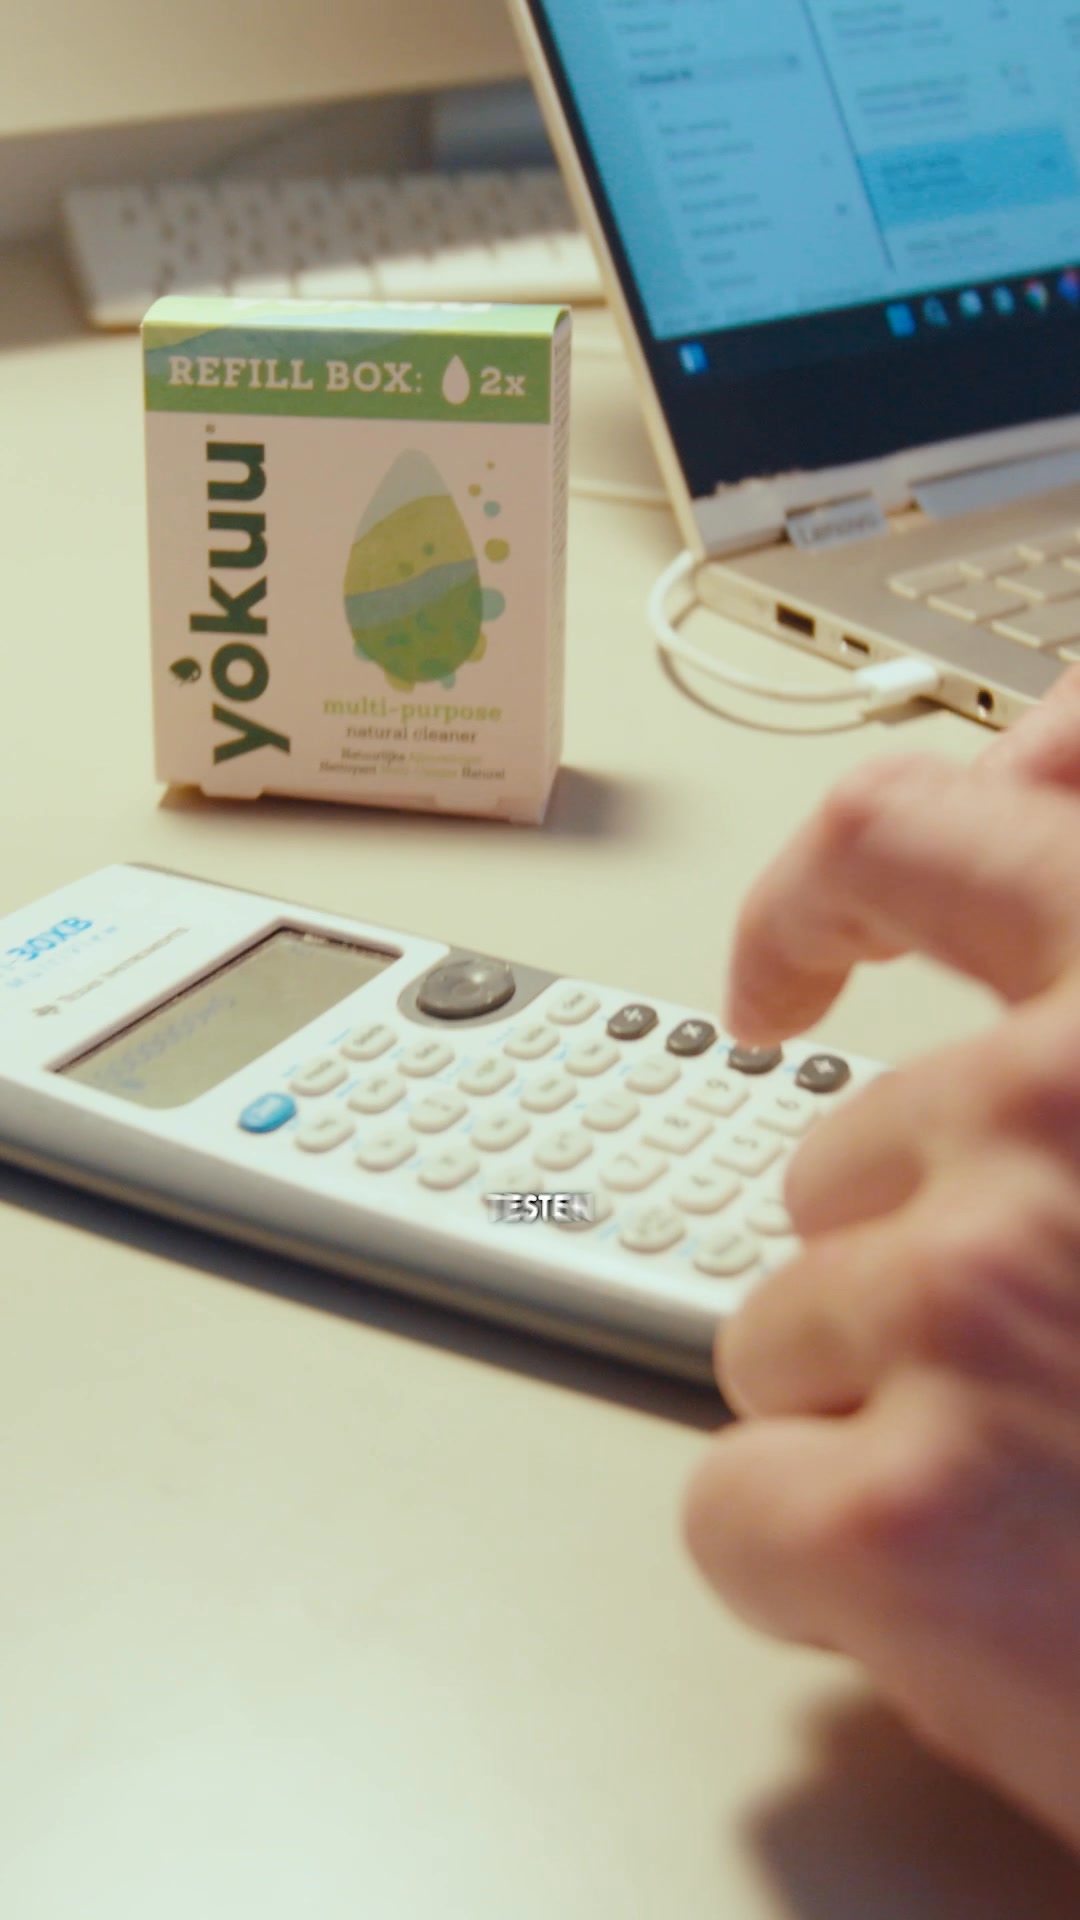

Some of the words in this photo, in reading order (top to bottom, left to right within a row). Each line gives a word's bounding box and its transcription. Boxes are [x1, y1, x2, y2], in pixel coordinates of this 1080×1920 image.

[168, 355, 314, 389] REFILL
[325, 360, 423, 394] BOX:
[480, 367, 527, 396] 2x
[188, 440, 291, 766] yokuu
[322, 696, 503, 724] multi-purpose
[346, 726, 408, 742] natural
[412, 727, 478, 744] cleaner
